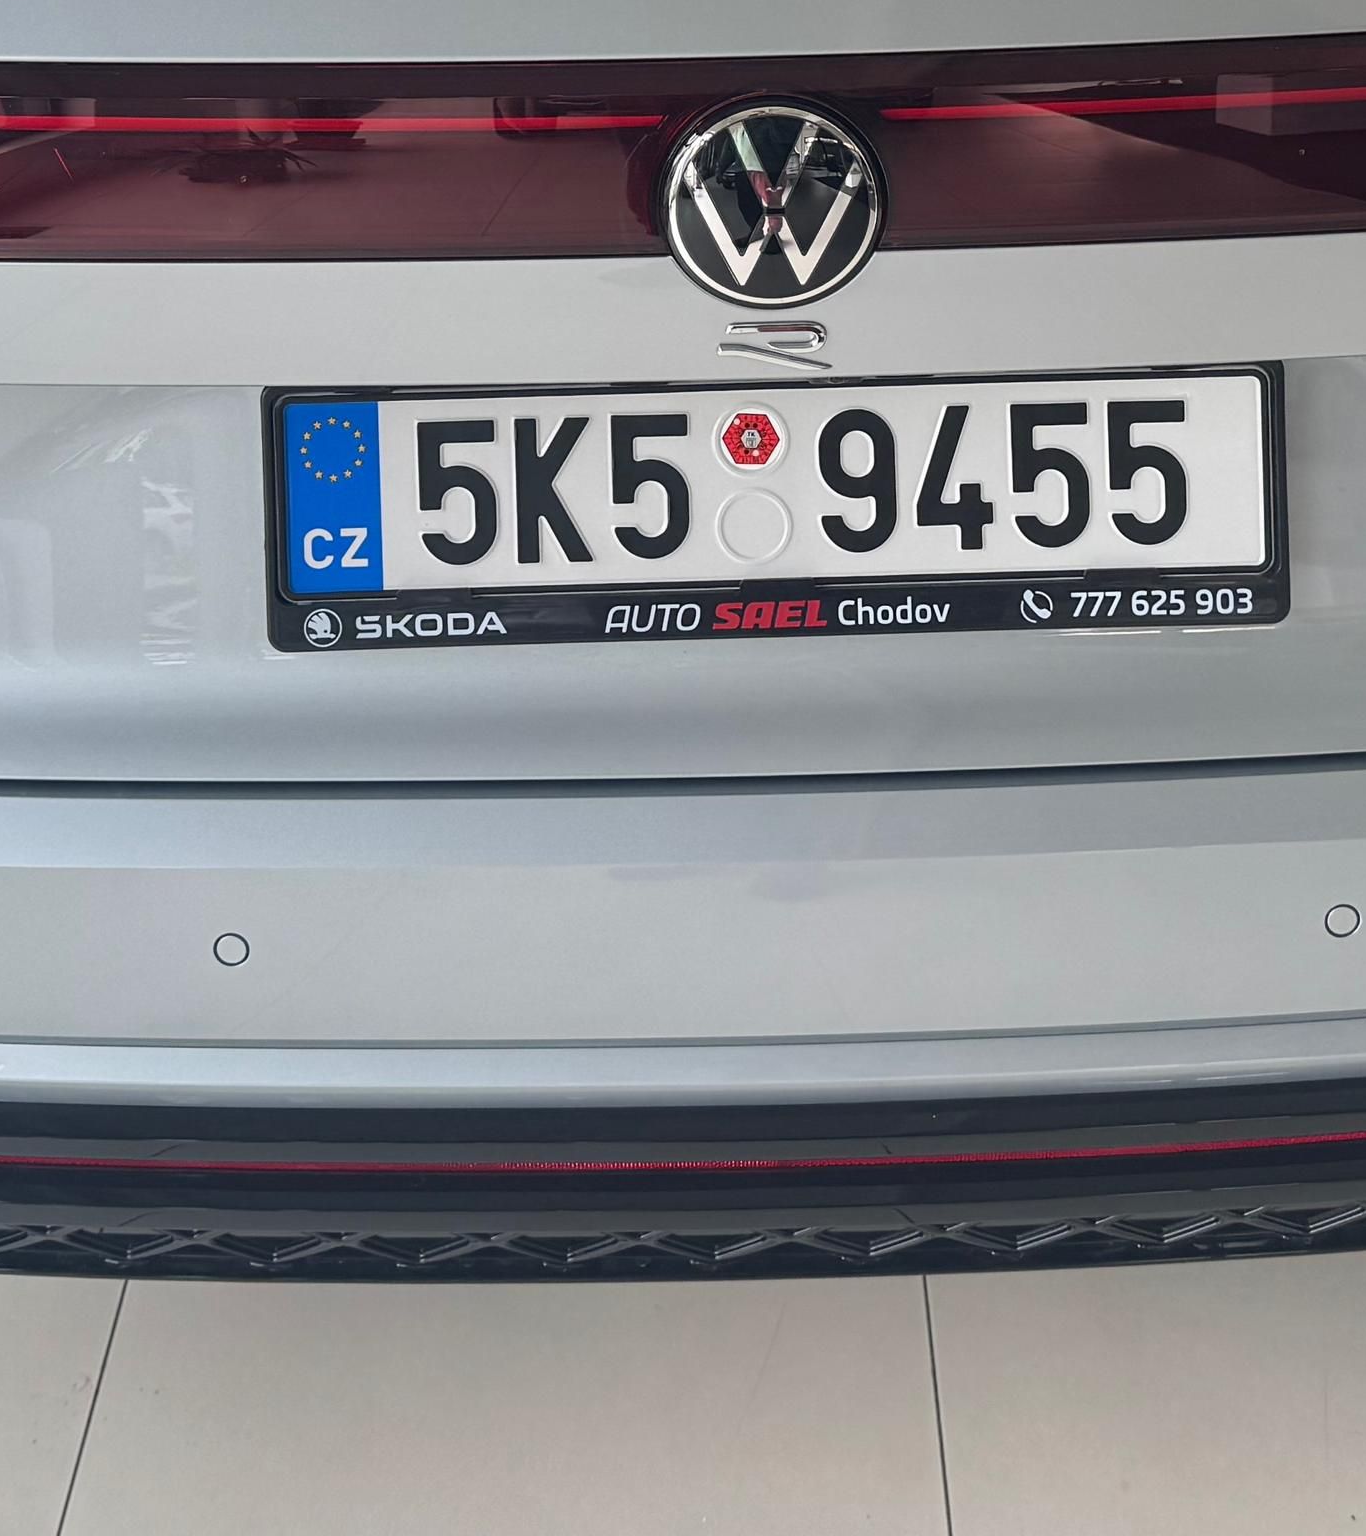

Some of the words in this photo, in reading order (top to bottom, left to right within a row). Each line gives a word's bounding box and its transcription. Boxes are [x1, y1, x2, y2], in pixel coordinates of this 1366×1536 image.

[682, 119, 866, 287] VW
[717, 321, 833, 371] R
[416, 413, 690, 566] 5K5
[818, 399, 1187, 553] 9455
[303, 527, 369, 569] CZ
[604, 603, 702, 634] AUTO
[713, 599, 828, 631] SAEL
[837, 595, 951, 626] Chodov
[1070, 591, 1122, 618] 777
[1131, 589, 1186, 617] 625
[1195, 587, 1253, 615] 903
